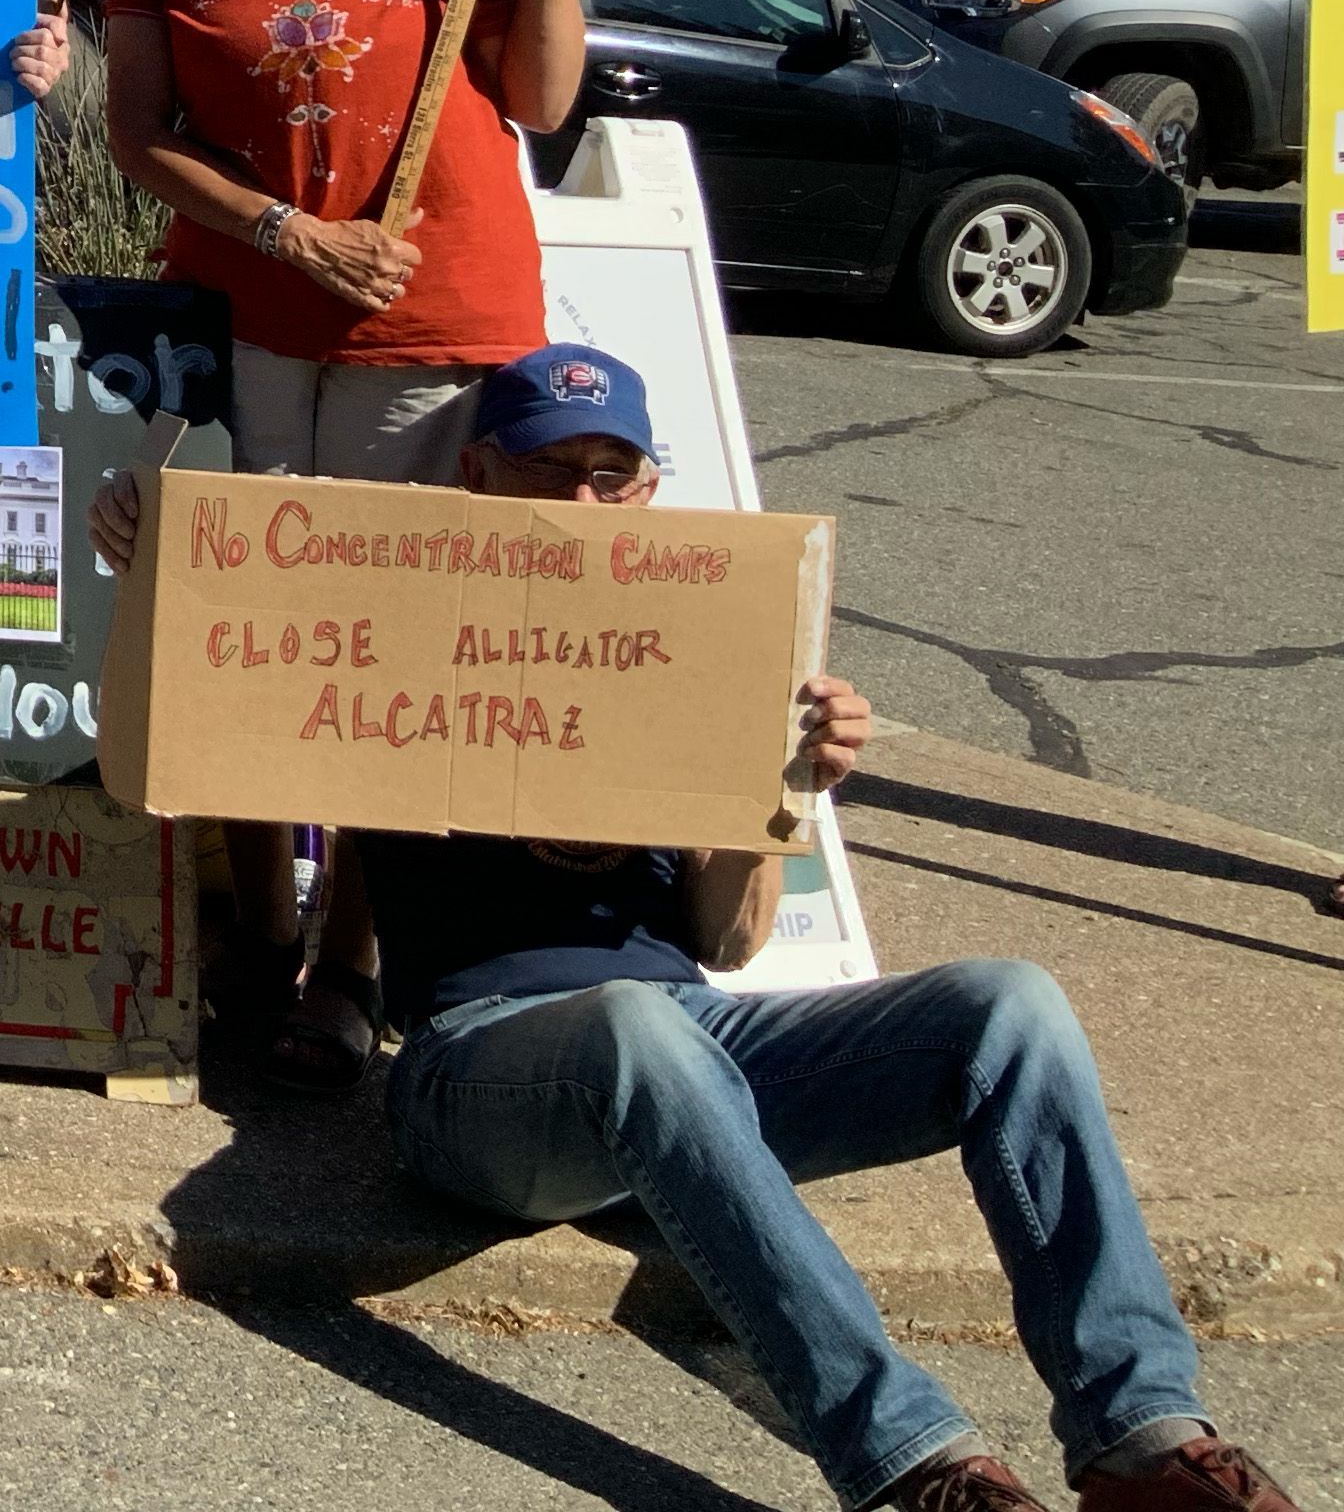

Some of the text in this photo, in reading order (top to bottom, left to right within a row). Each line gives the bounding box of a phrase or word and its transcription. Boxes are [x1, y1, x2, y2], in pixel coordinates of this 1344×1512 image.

[558, 294, 597, 346] RELAX
[206, 618, 672, 669] CLOSE ALLIGATOR
[299, 684, 588, 753] ALCATRAZ
